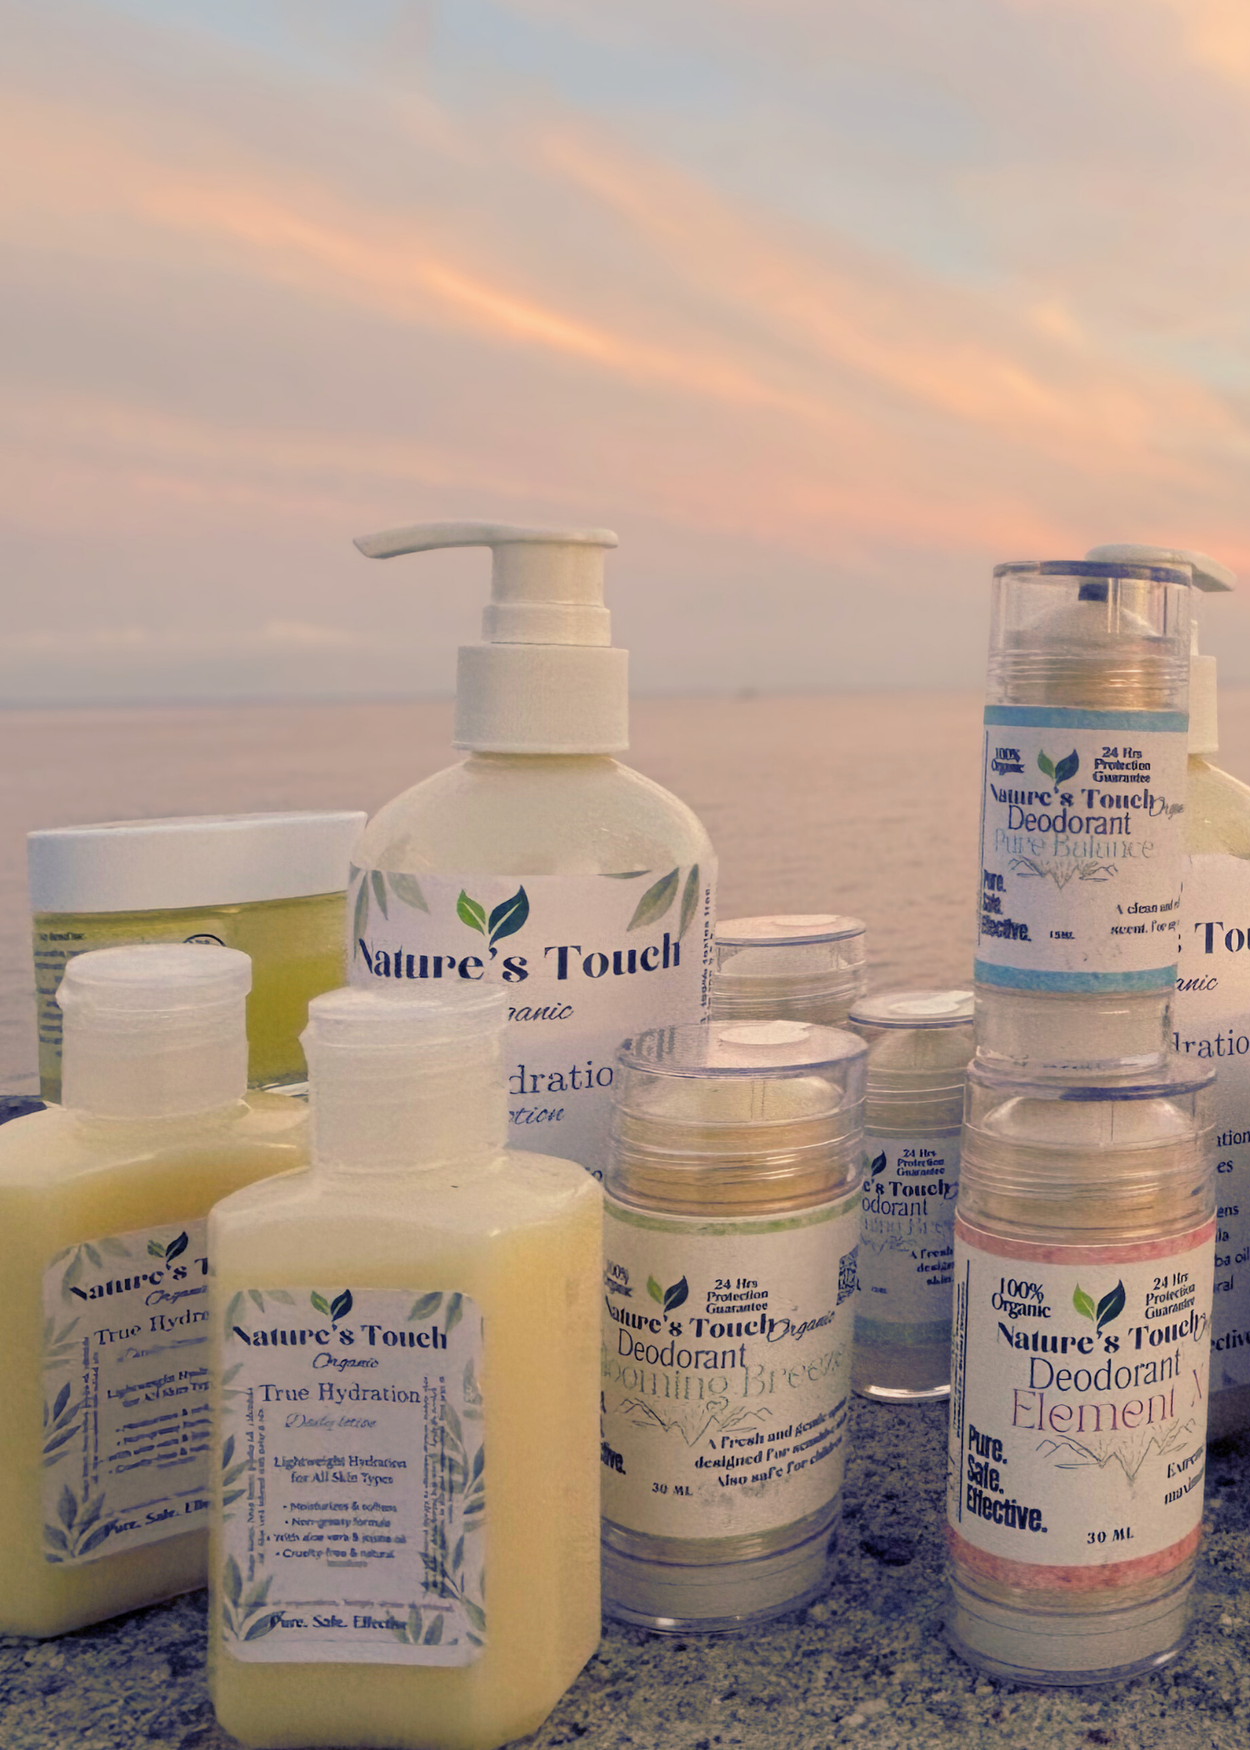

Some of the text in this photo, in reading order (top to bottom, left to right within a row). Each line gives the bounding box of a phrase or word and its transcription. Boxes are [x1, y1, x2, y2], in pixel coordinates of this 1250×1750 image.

[1102, 747, 1142, 758] 24 Hrs
[1094, 758, 1150, 771] Protection
[1093, 771, 1150, 784] Guarantee
[990, 783, 1155, 809] Nature's Touch
[1008, 805, 1131, 835] Deodorant
[995, 828, 1155, 859] Pure Balance
[359, 932, 681, 983] Nature's Touch
[889, 1179, 949, 1197] Touch
[862, 1197, 928, 1216] odorant
[715, 1278, 758, 1290] 24 Hrs
[999, 1277, 1044, 1304] 100%
[1146, 1282, 1196, 1307] Protection
[1153, 1276, 1168, 1291] 24
[706, 1289, 769, 1303] Protection
[991, 1292, 1051, 1319] Organic
[706, 1302, 769, 1315] Guarantee
[1145, 1297, 1195, 1320] Guarantee
[233, 1324, 448, 1349] Nature's Touch
[689, 1313, 774, 1338] Touch
[998, 1309, 1199, 1354] Nature's Touch
[617, 1328, 747, 1370] Deodorant
[312, 1352, 380, 1372] Organic
[1029, 1348, 1181, 1392] Deodorant
[258, 1382, 421, 1405] True Hydration
[1012, 1385, 1175, 1434] Element
[721, 1425, 793, 1449] fresh and
[968, 1424, 1007, 1465] Pure.
[695, 1448, 790, 1470] designed for
[310, 1471, 329, 1483] All
[718, 1474, 748, 1487] Also
[967, 1454, 1005, 1495] Safe.
[652, 1483, 693, 1497] 30 ML
[966, 1483, 1048, 1534] Effective.
[1086, 1526, 1135, 1545] 30 ML
